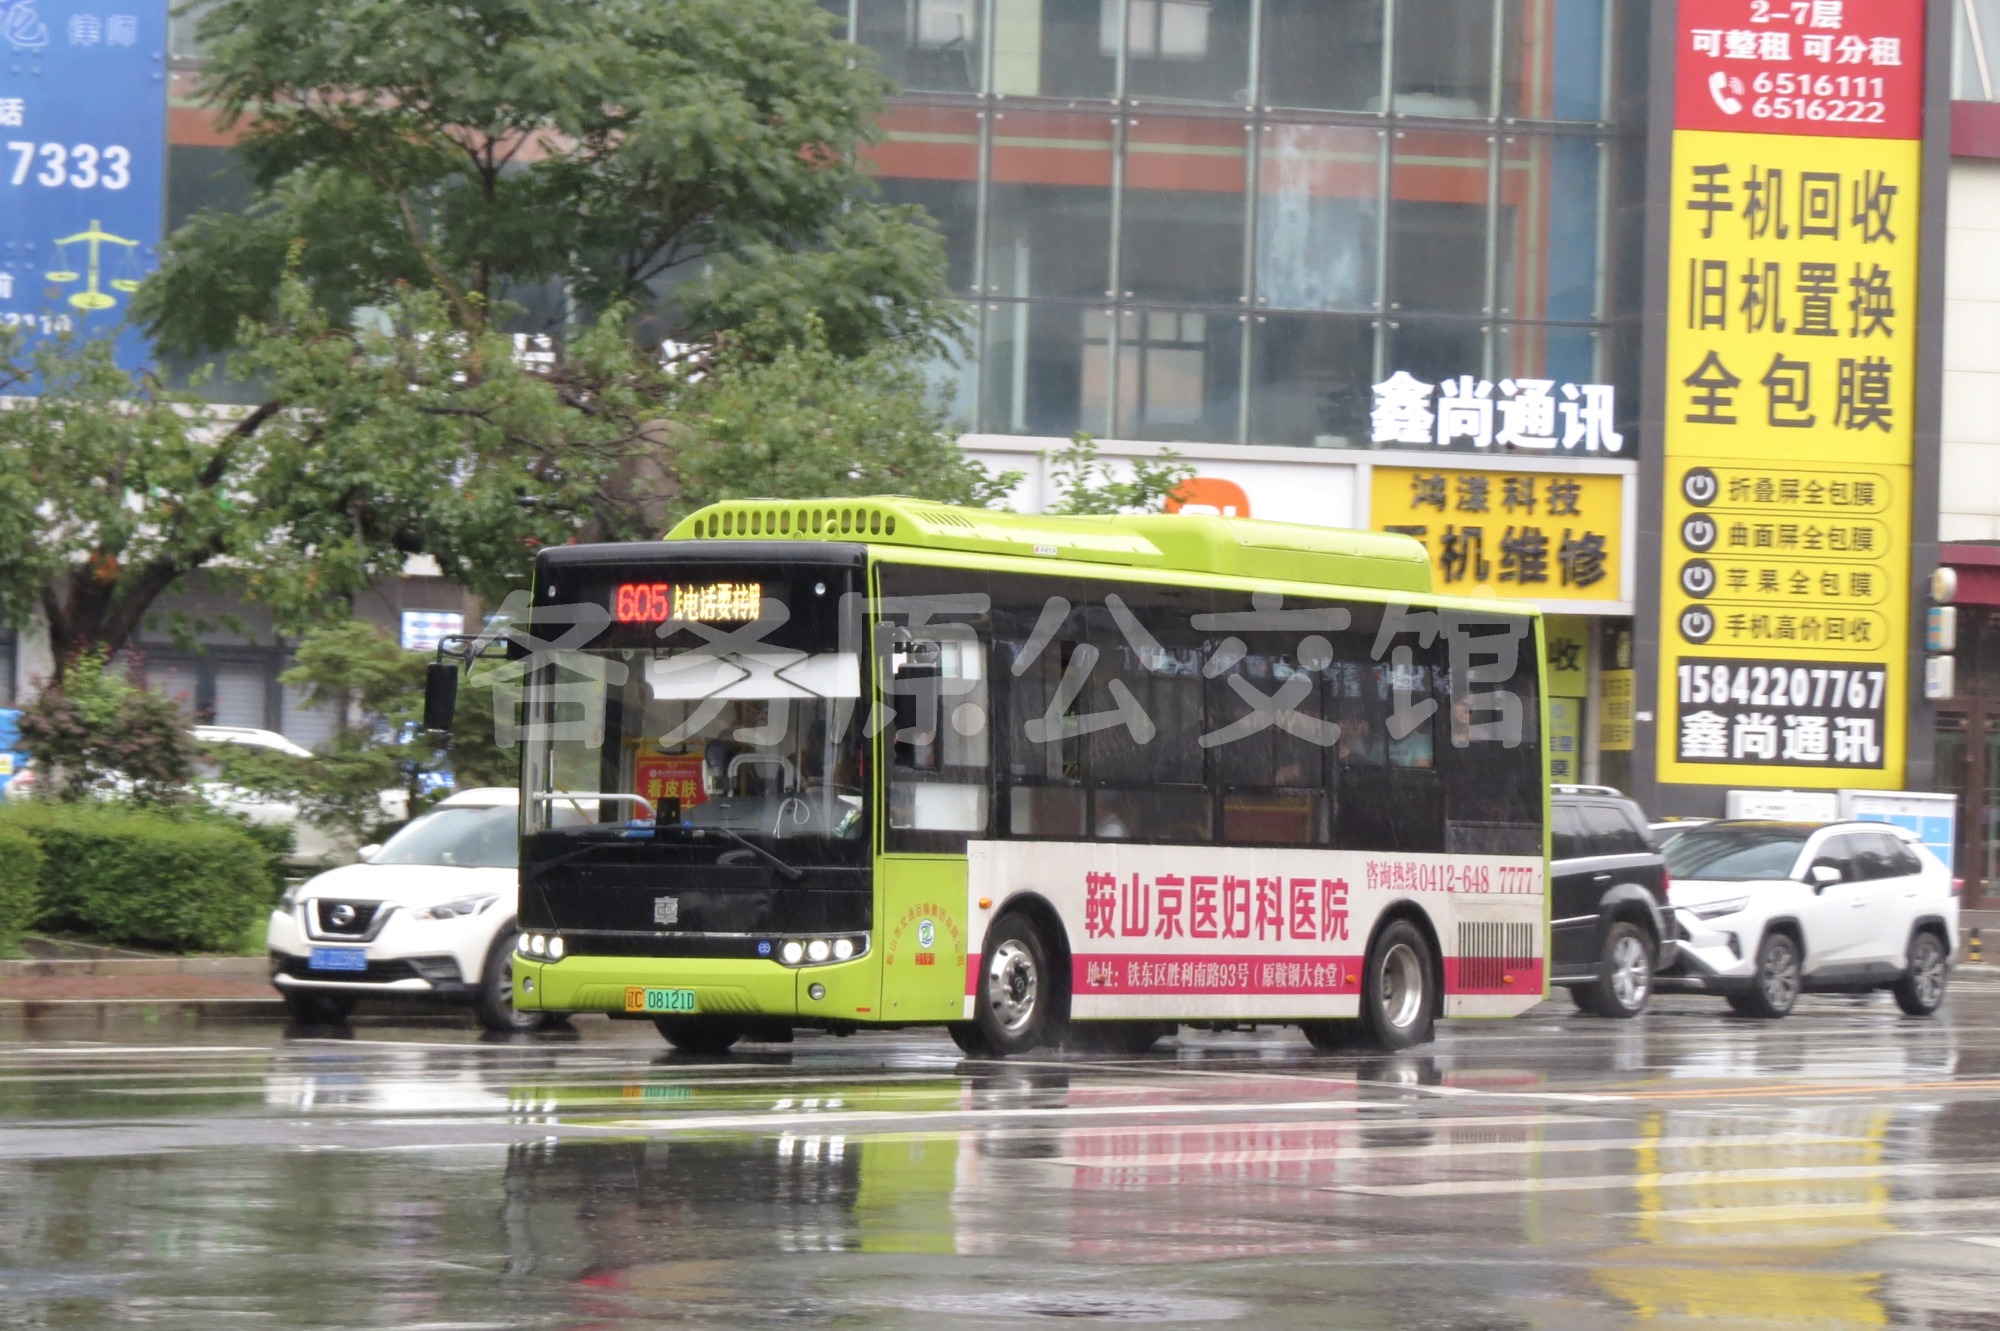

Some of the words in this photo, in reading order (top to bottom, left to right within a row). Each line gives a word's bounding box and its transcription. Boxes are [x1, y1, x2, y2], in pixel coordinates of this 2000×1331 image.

[1750, 0, 1843, 29] 2-7层
[1691, 29, 1792, 61] 可整租
[1802, 34, 1902, 66] 可分租
[1753, 72, 1884, 98] 6516111
[1752, 97, 1885, 123] 6516222
[1687, 163, 1898, 244] 手机回收
[1687, 257, 1895, 338] 旧机置换
[1683, 350, 1894, 433] 全包膜
[1370, 370, 1624, 452] 鑫尚通讯
[1728, 477, 1875, 507] 折叠屏全包膜
[1728, 522, 1873, 552] 曲面屏全包膜
[1725, 567, 1873, 597] 苹果全包膜
[618, 584, 669, 621] 605
[1725, 613, 1872, 643] 手机高价回收
[1678, 664, 1886, 709] 15842207767
[1681, 710, 1880, 763] 鑫尚通讯
[1499, 866, 1533, 893] 7777
[1085, 871, 1349, 942] 鞍山京医妇科医院
